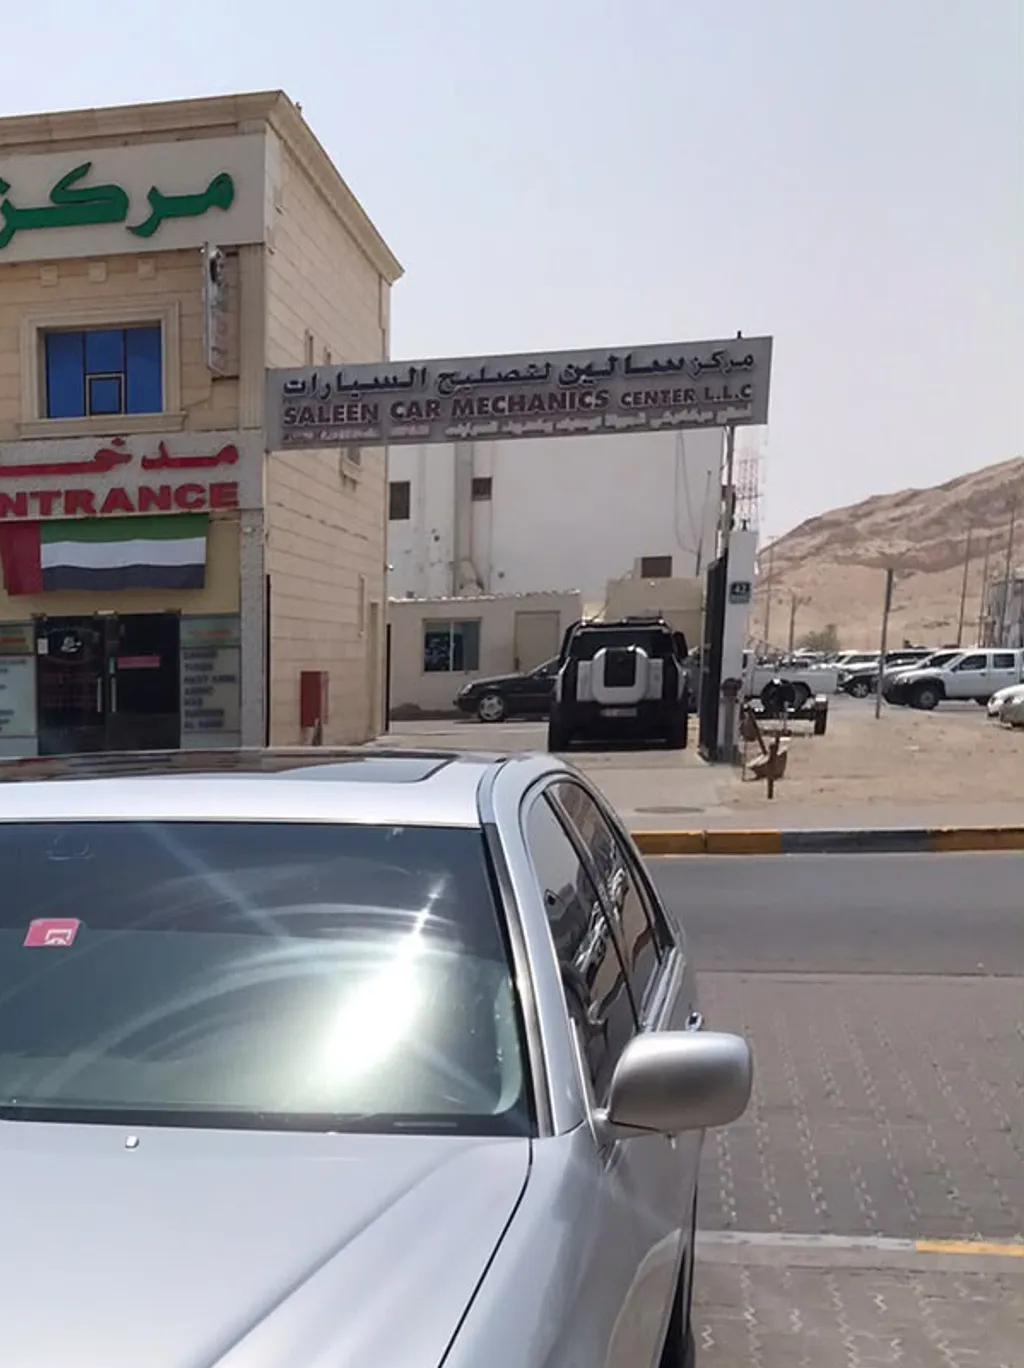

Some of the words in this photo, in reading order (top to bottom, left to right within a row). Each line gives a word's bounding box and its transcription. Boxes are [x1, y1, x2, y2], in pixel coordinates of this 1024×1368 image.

[690, 350, 754, 377] مركز
[282, 366, 427, 400] السيارات
[282, 403, 379, 426] SALEEN
[389, 400, 442, 419] CAR
[451, 388, 610, 417] MECHANICS
[620, 387, 696, 407] CENTER
